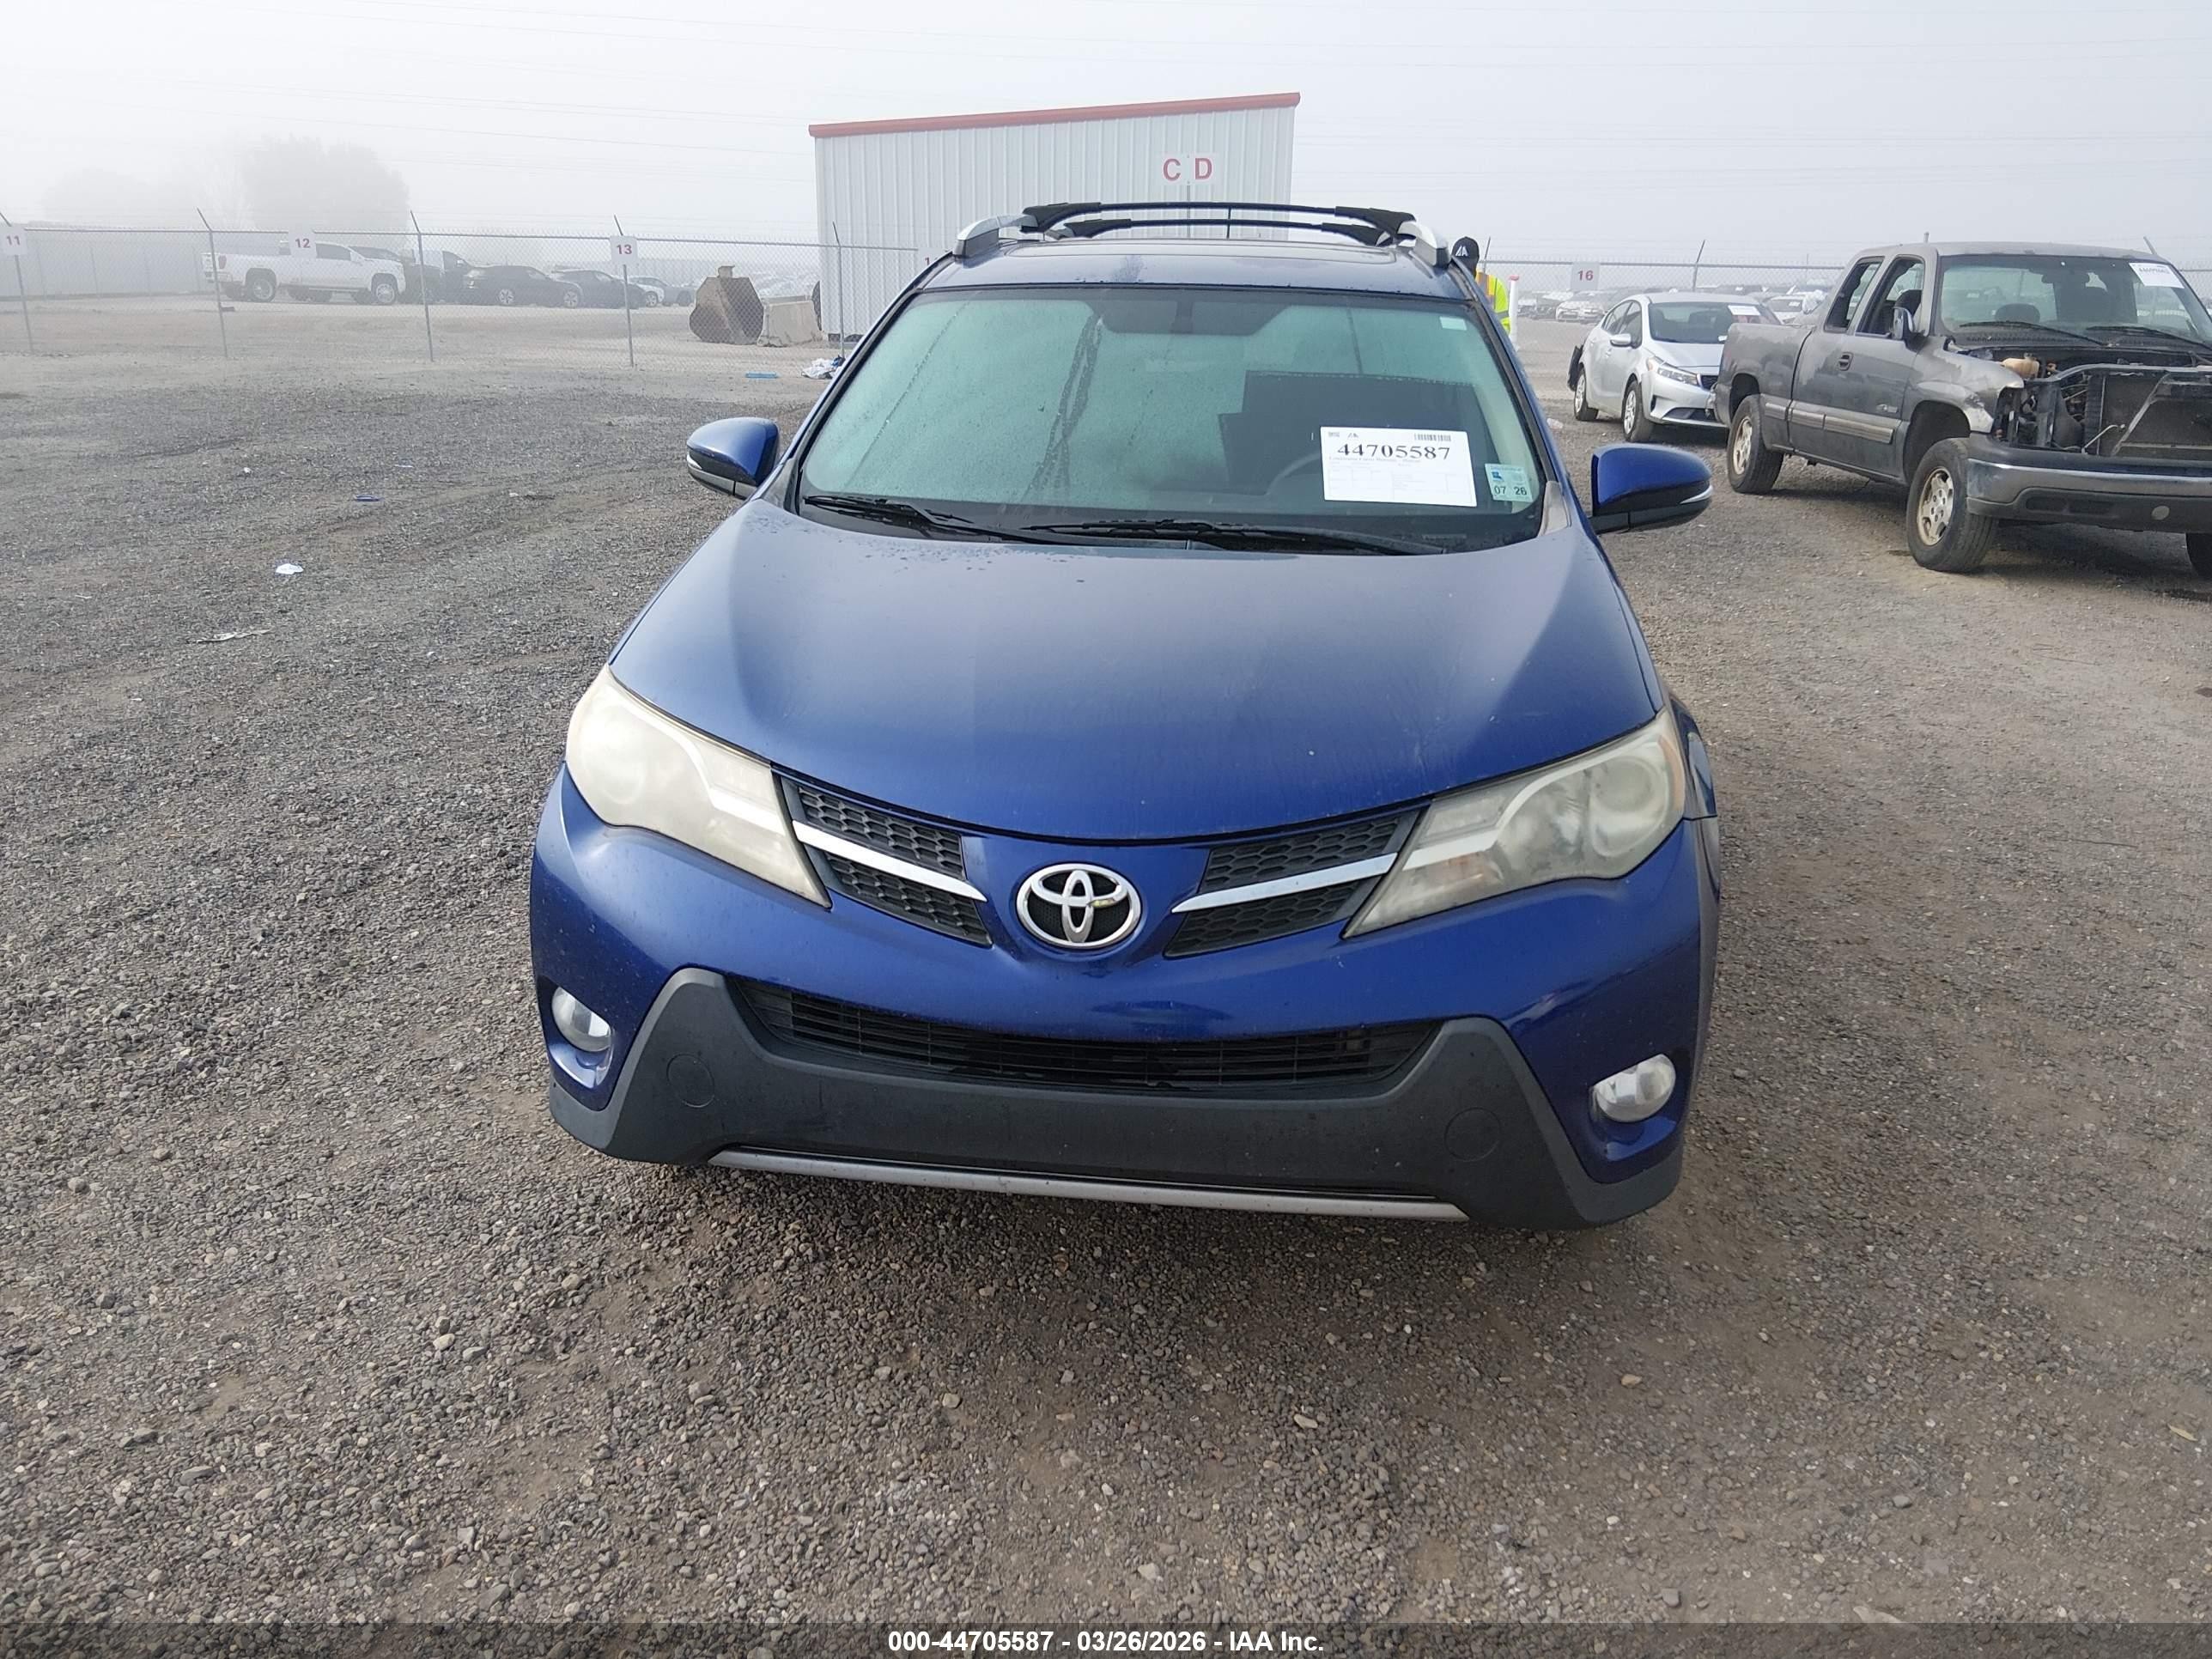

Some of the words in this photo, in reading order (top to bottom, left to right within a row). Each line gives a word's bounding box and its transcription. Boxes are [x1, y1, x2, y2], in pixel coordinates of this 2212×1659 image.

[1163, 158, 1182, 181] C
[1194, 157, 1212, 180] D
[6, 235, 21, 246] 11
[295, 238, 311, 248] 12
[616, 244, 633, 255] 13
[1577, 270, 1594, 282] 16
[1337, 443, 1450, 460] 44705587
[1494, 485, 1506, 495] 07
